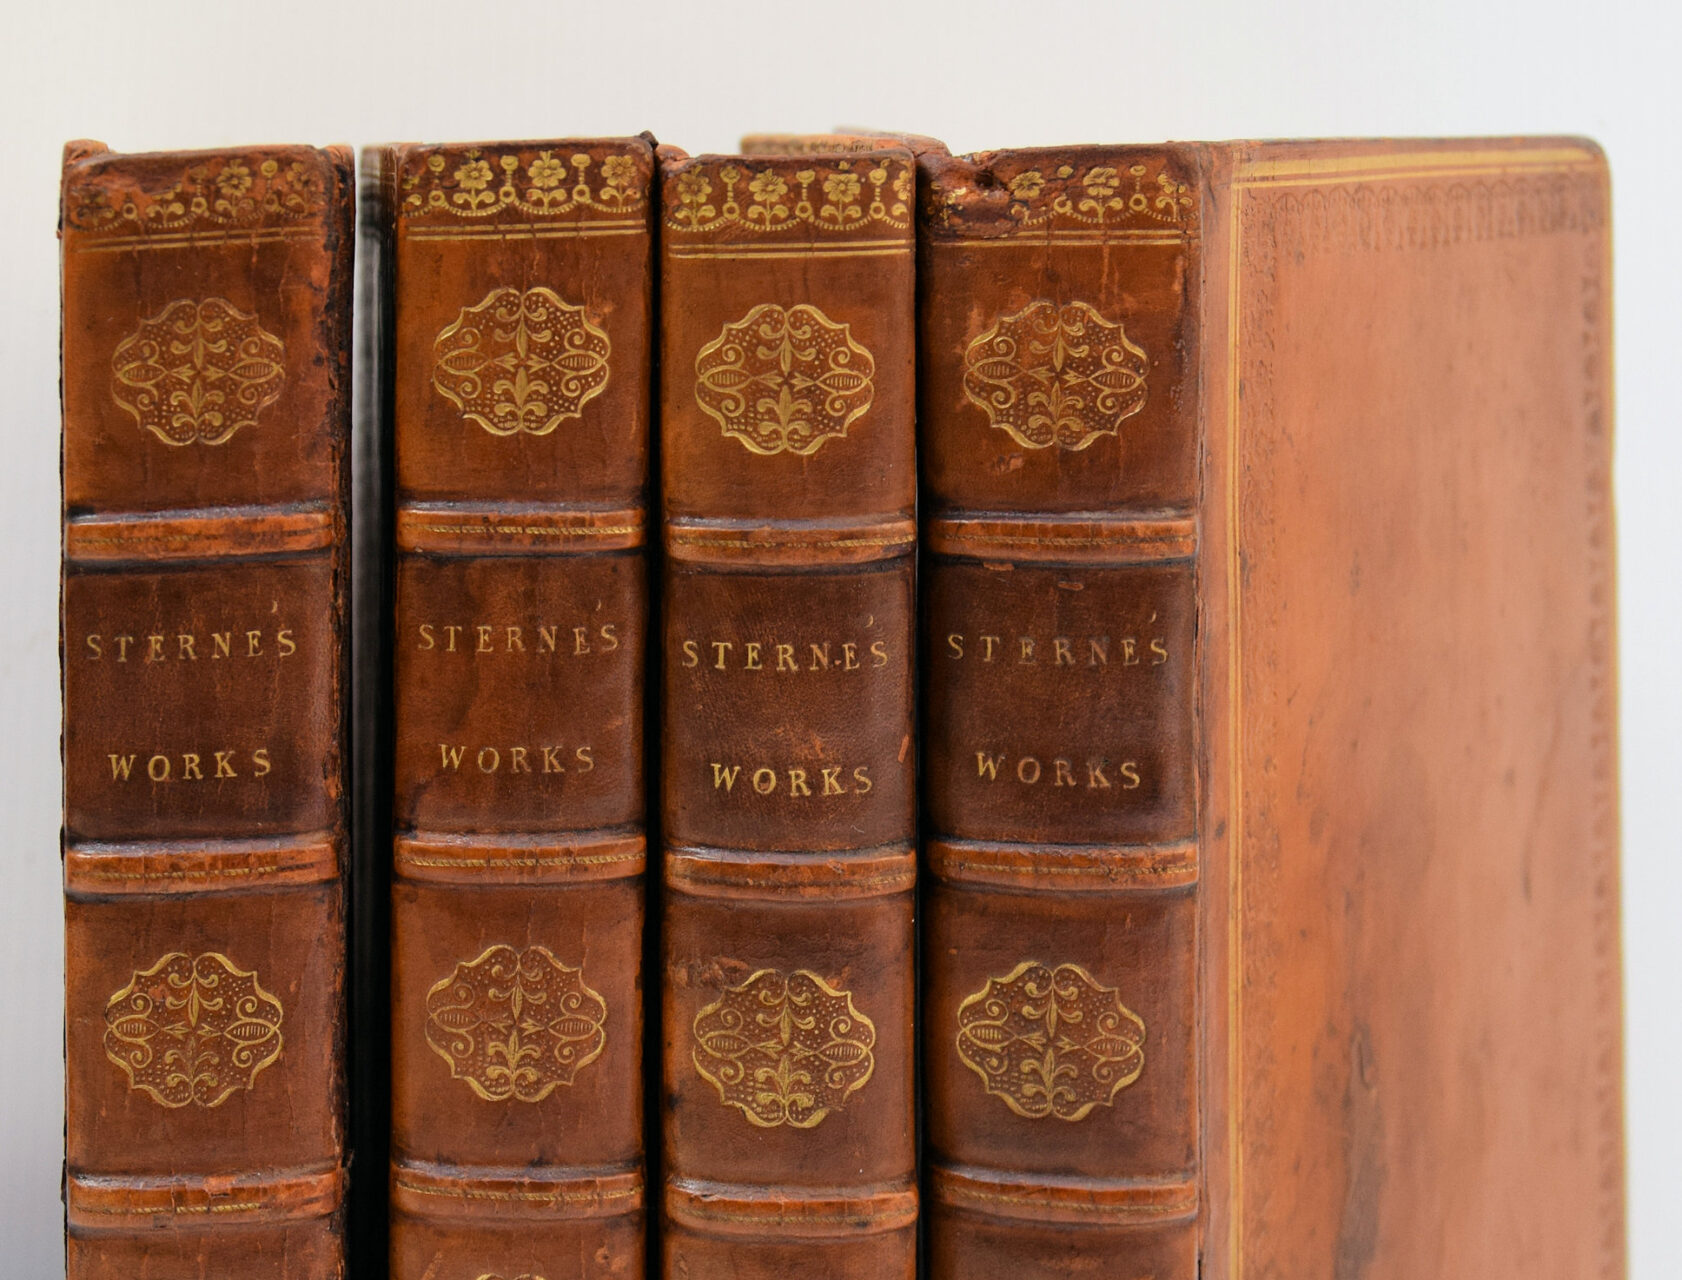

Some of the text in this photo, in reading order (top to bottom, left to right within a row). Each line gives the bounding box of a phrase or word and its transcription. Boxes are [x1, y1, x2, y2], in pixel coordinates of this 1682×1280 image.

[108, 748, 271, 782] WORKS
[438, 743, 595, 774] WORKS
[976, 751, 1141, 789] WORKS
[710, 762, 873, 797] WORKS
